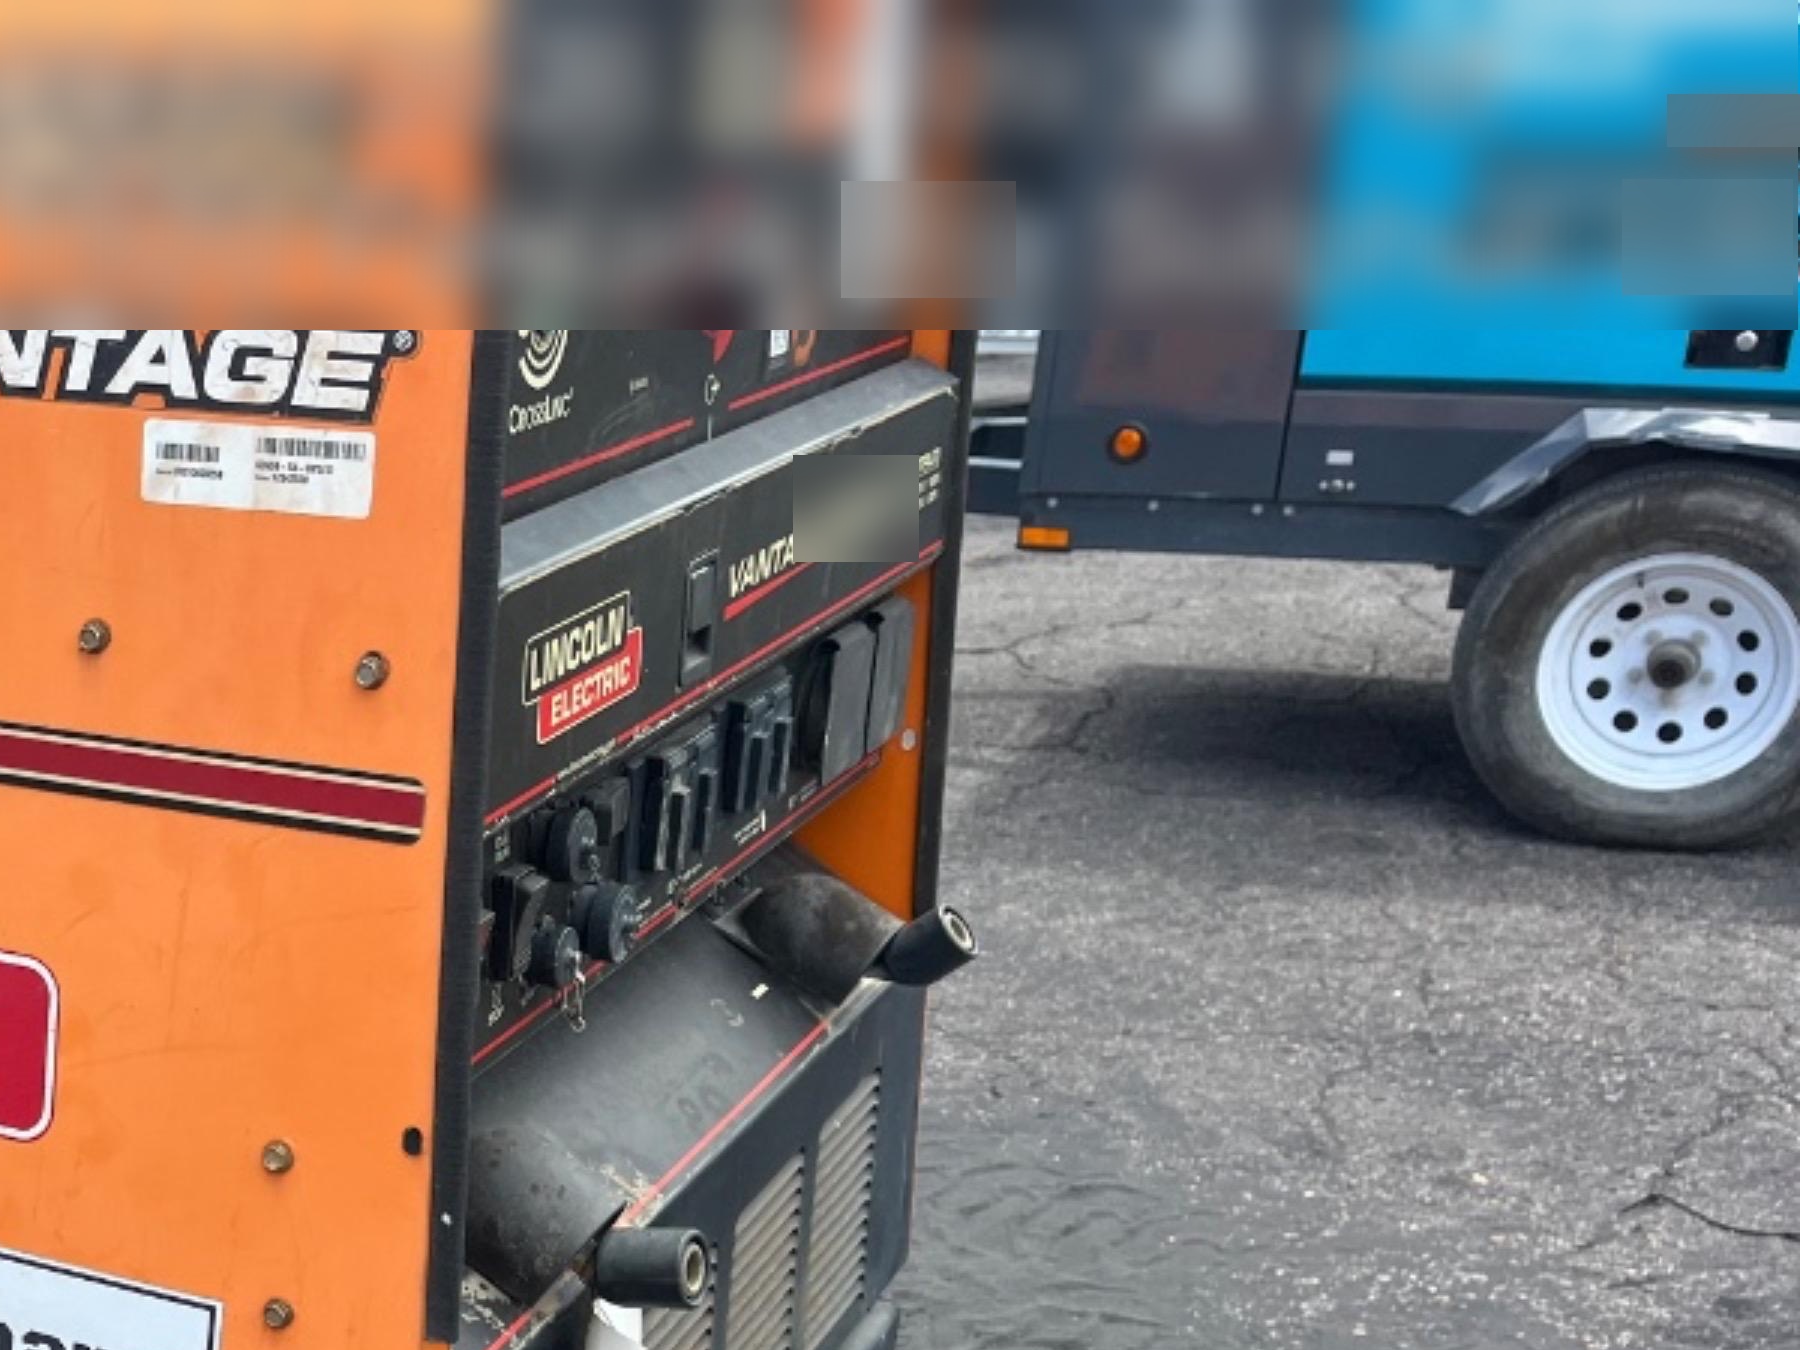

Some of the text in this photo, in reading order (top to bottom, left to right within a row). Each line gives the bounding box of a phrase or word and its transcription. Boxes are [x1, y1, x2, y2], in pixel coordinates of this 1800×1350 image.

[729, 533, 794, 598] VANTA
[530, 605, 625, 692] LINCOLN
[550, 657, 632, 726] ELECTRIC
